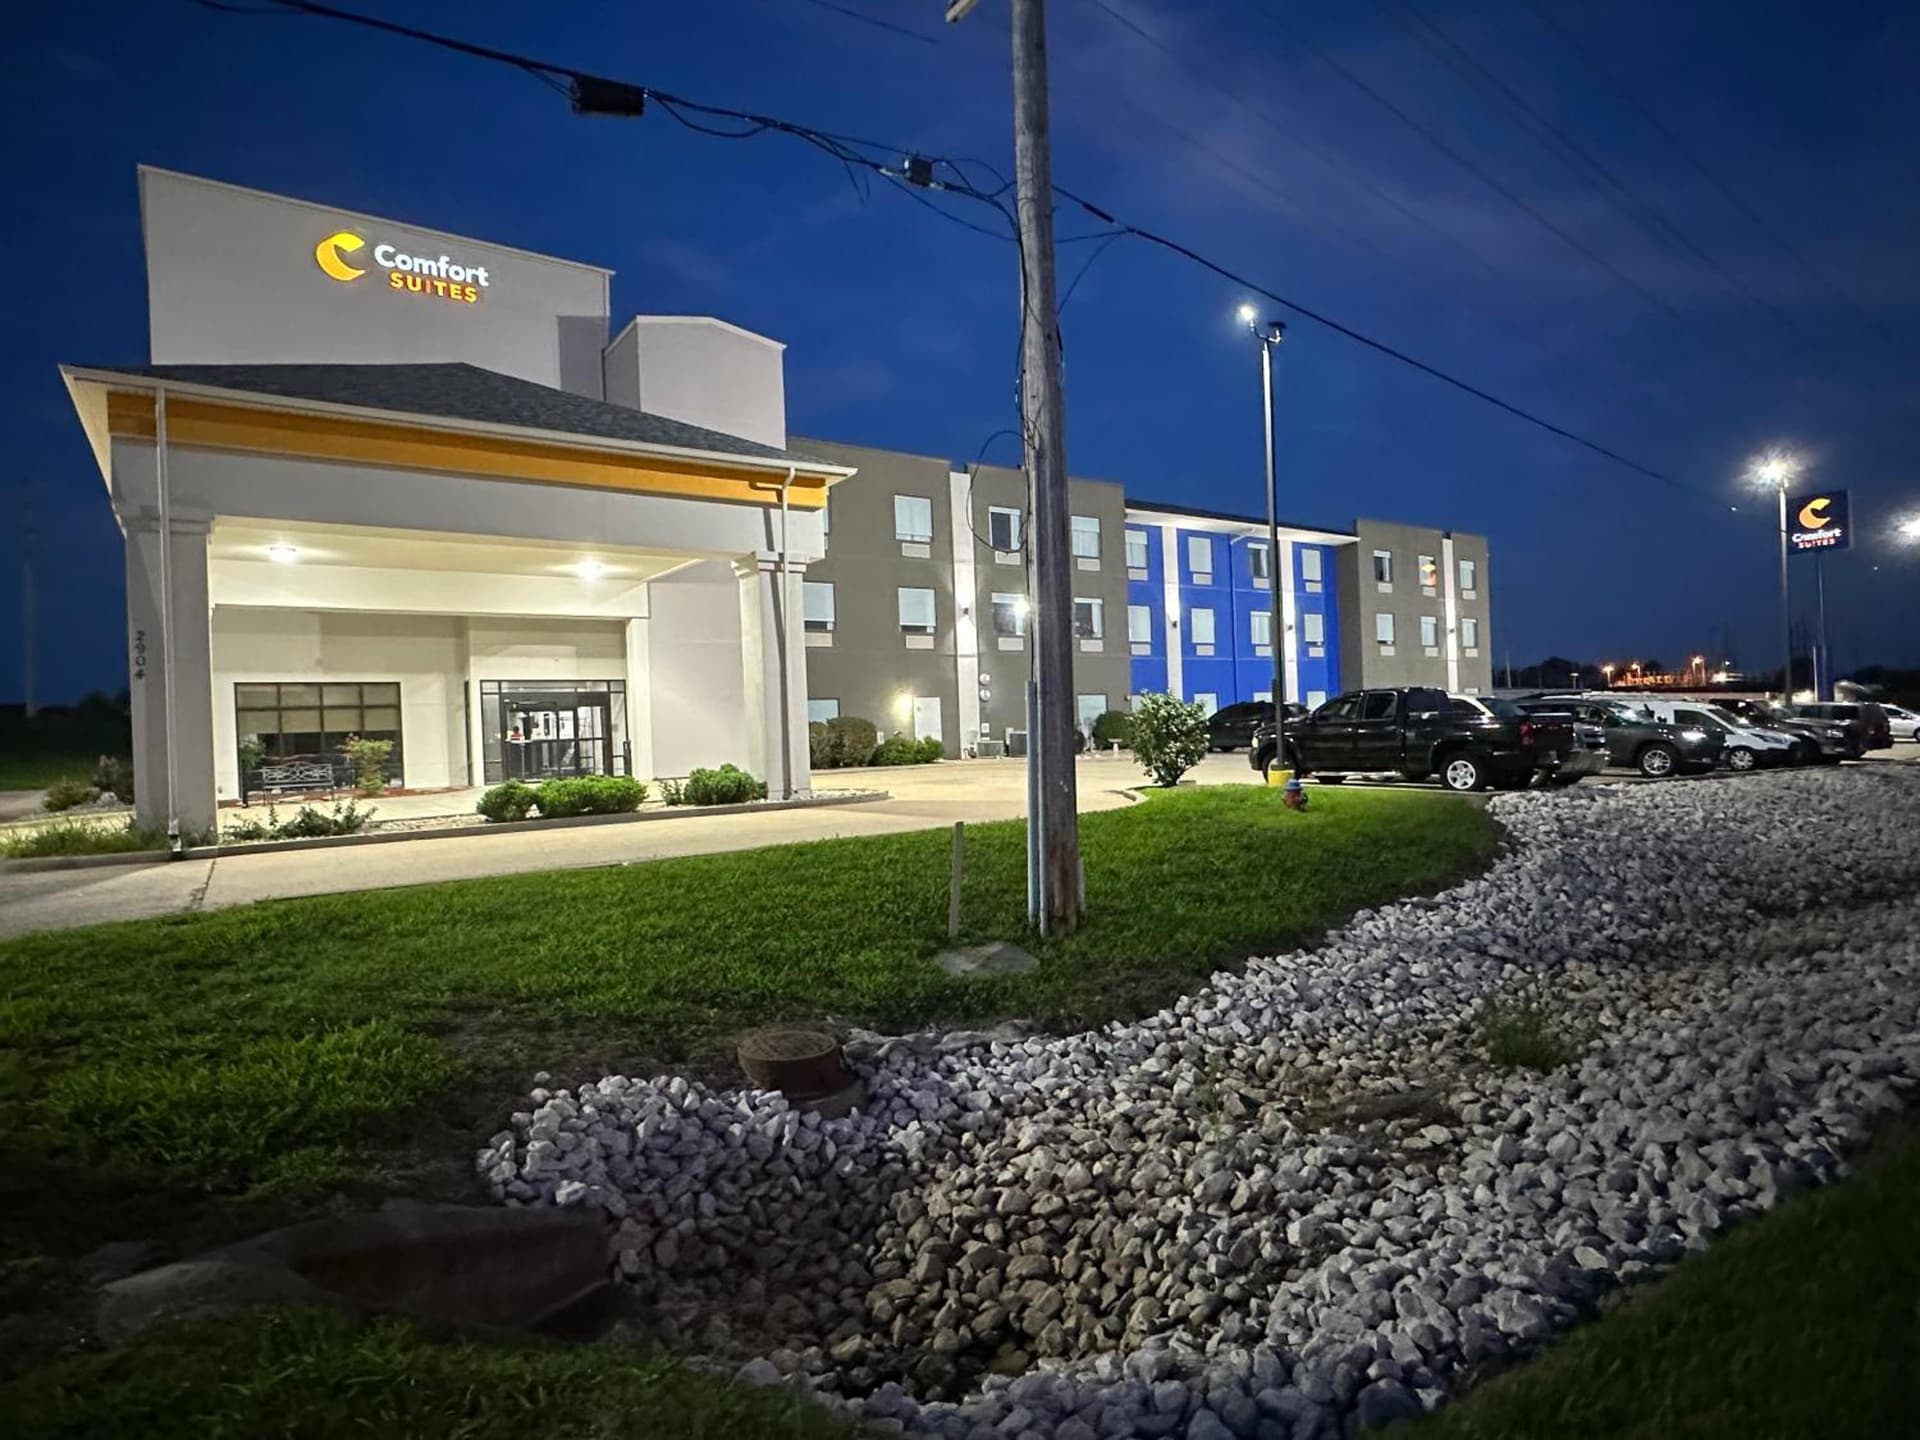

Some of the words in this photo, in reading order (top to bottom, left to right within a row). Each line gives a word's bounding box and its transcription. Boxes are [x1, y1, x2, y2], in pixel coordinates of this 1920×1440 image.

[374, 244, 490, 287] Comfort
[389, 271, 479, 304] SUITES
[1791, 528, 1842, 543] Comfort
[1798, 538, 1836, 549] SUITES
